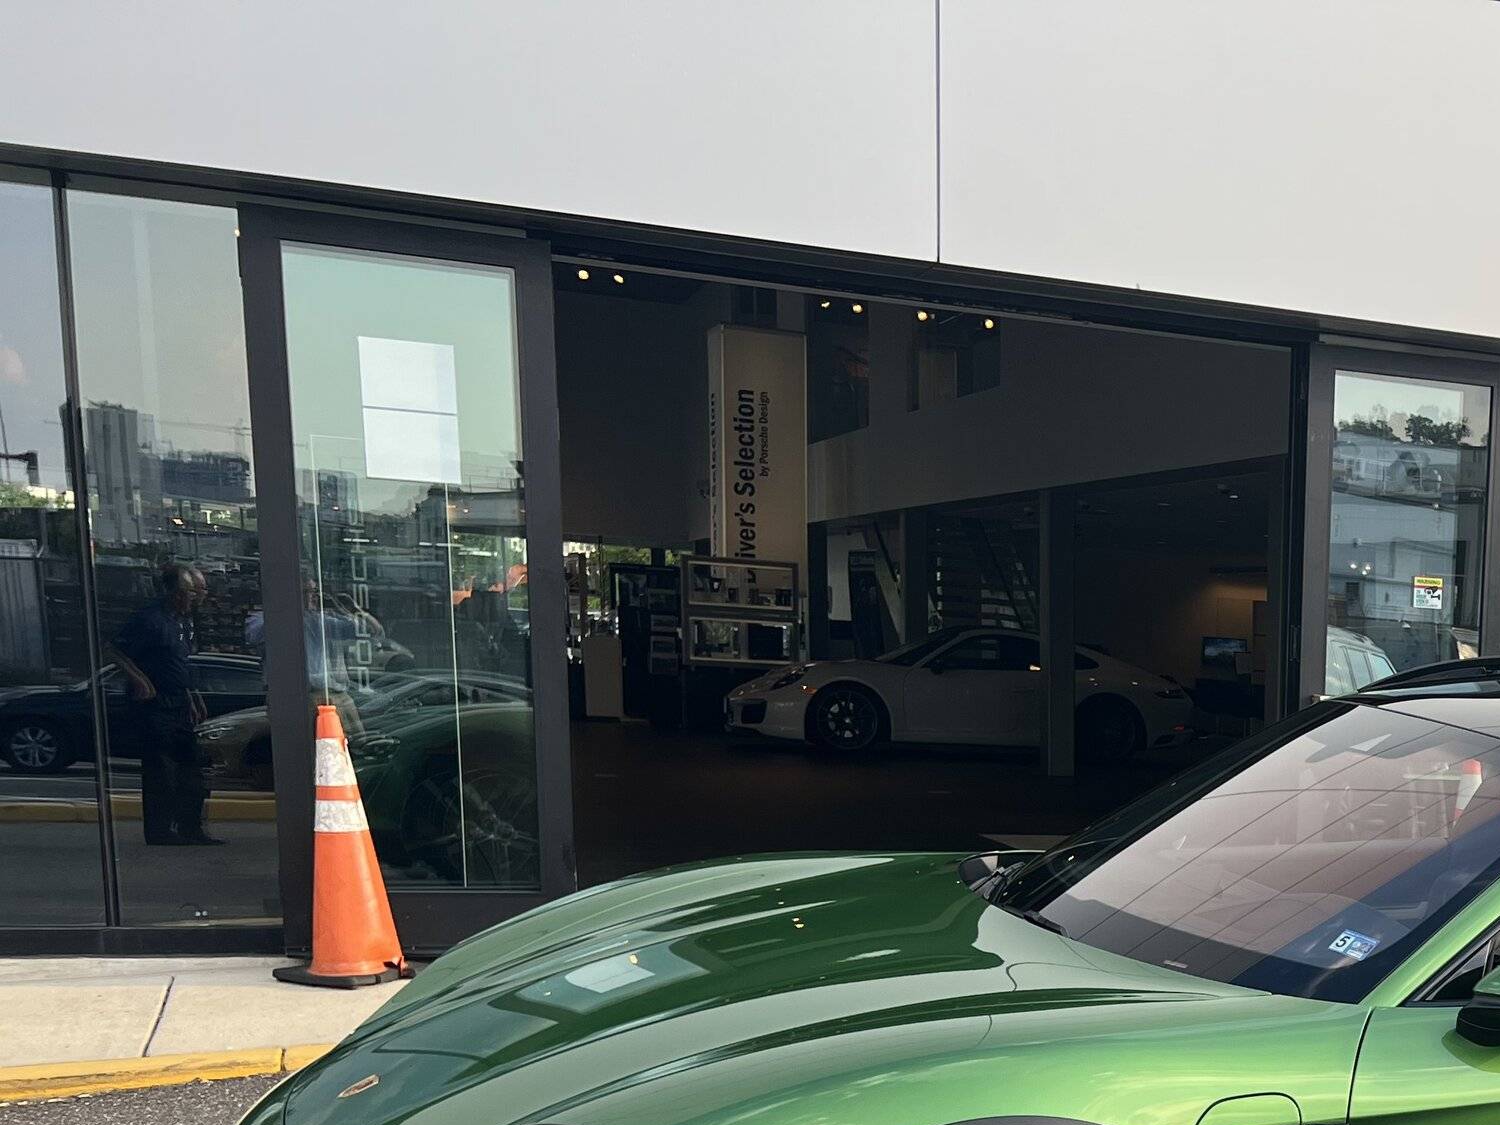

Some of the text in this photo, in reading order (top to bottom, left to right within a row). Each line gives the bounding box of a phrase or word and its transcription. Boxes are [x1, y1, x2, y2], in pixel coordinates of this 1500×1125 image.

[759, 391, 770, 424] Design
[759, 466, 769, 477] by
[733, 388, 757, 584] iver's Selection
[1336, 936, 1350, 947] 5
